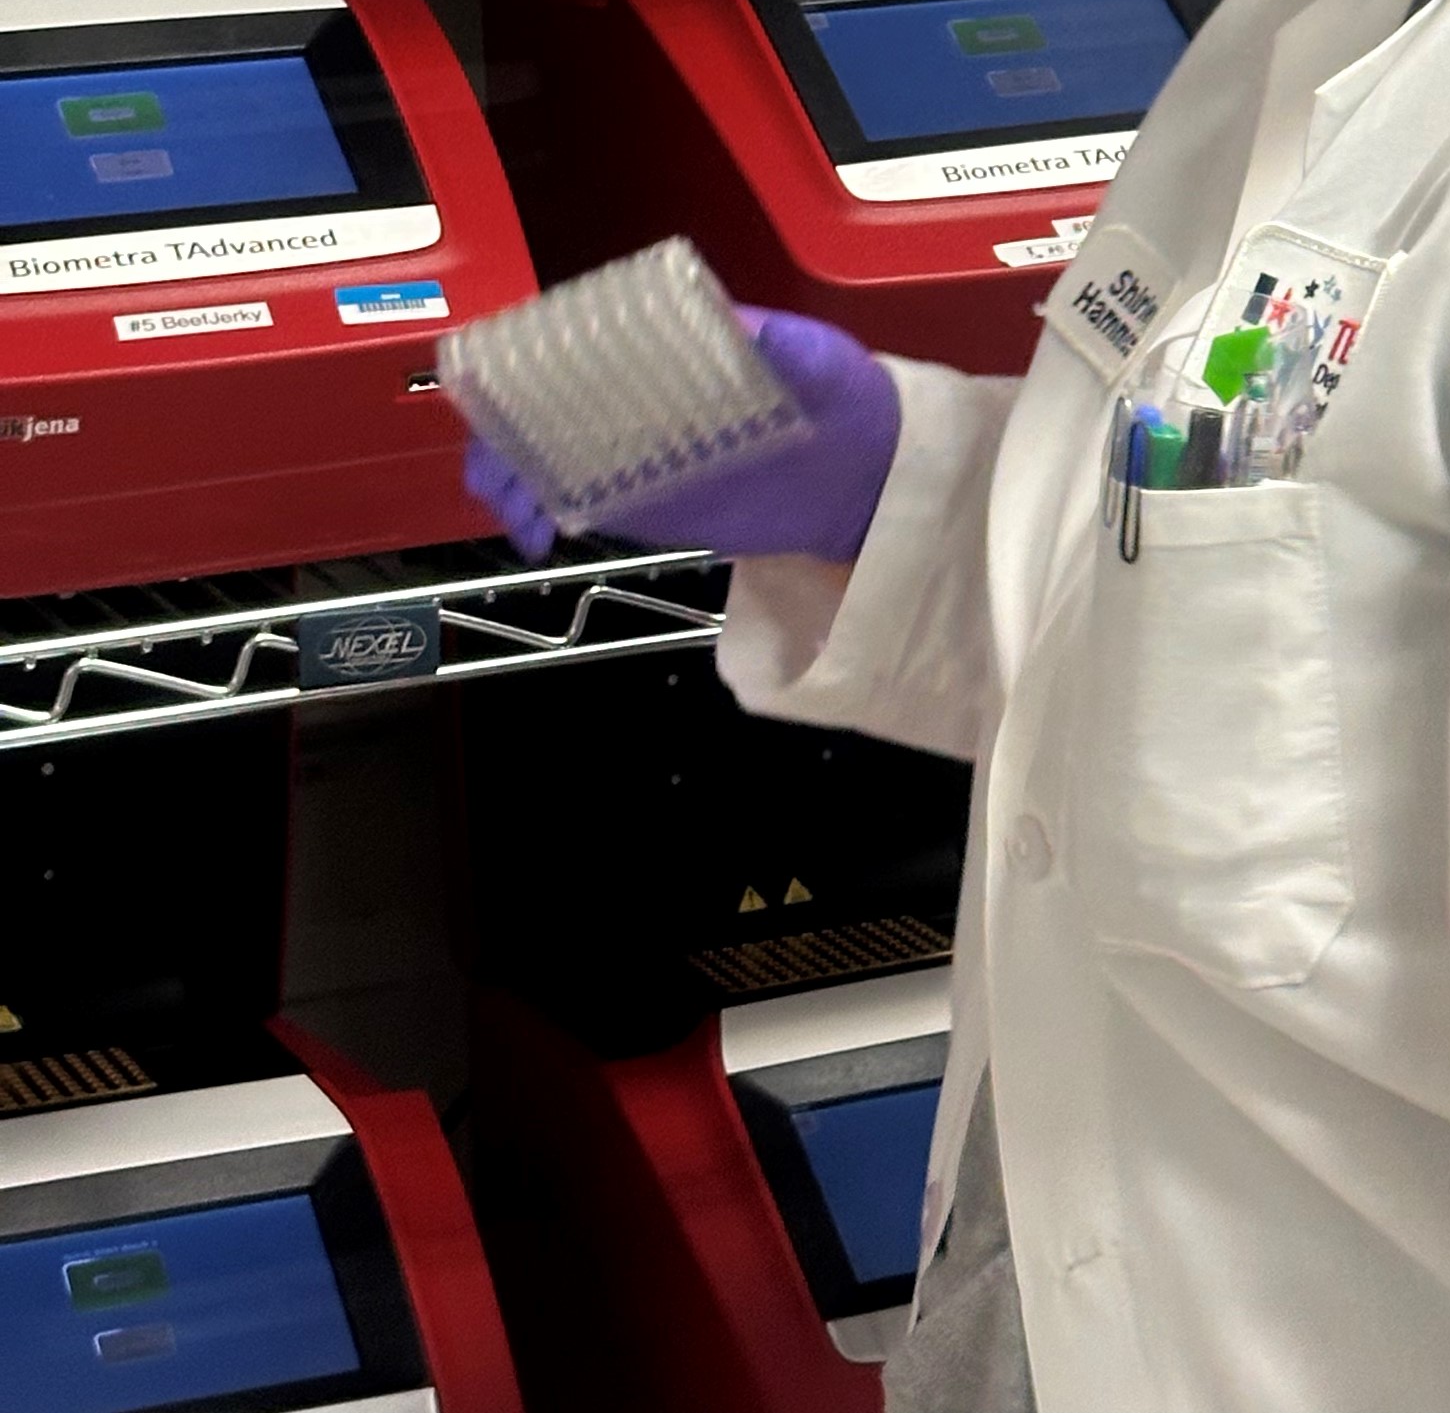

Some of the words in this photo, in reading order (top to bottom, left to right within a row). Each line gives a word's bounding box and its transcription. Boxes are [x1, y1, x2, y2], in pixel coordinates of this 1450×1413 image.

[941, 156, 1071, 184] Biometra
[9, 250, 157, 278] Biometra
[164, 229, 338, 261] TAdvanced
[129, 319, 156, 333] #5
[163, 306, 262, 330] BeefJerky
[320, 629, 423, 659] NEXEL
